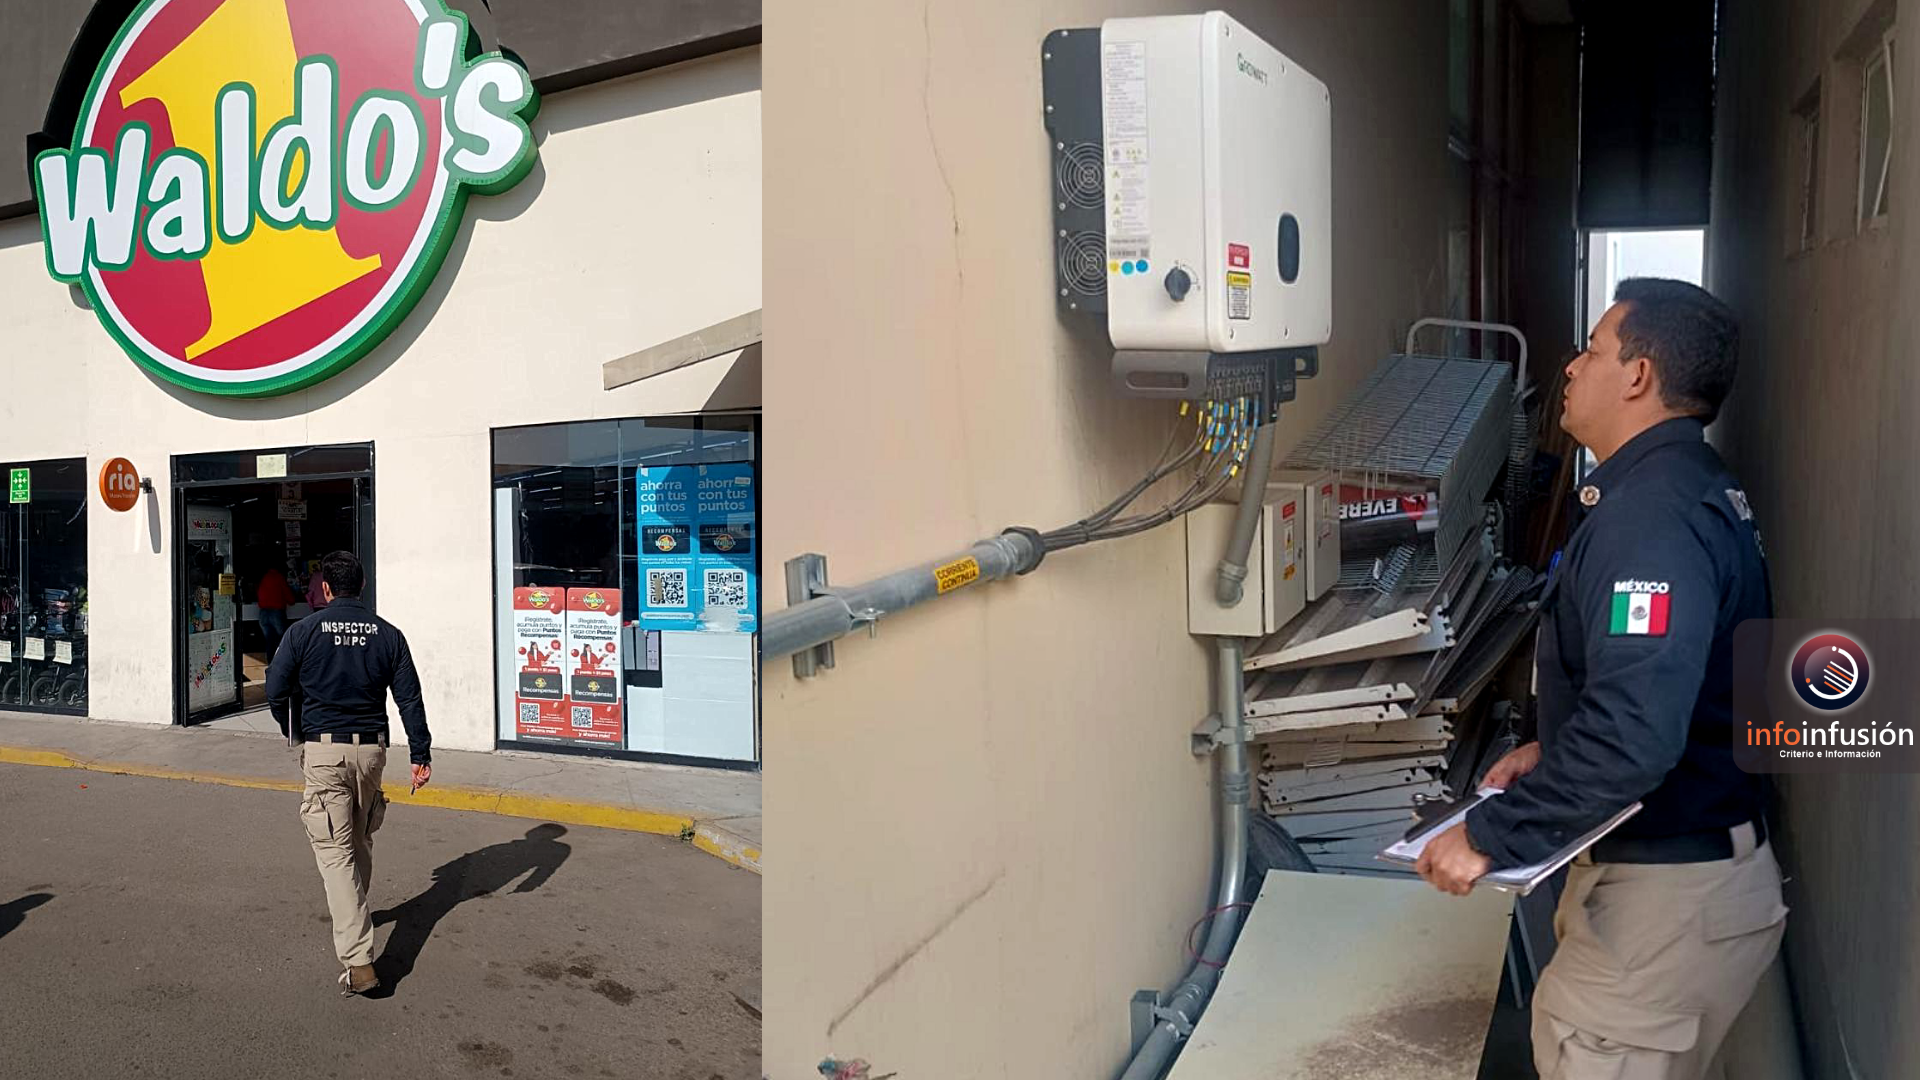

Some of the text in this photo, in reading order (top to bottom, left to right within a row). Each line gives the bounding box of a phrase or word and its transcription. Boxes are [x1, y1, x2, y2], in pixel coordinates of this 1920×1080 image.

[38, 20, 525, 276] Waldo's
[109, 464, 136, 491] ria
[640, 480, 682, 491] ahorra
[698, 478, 736, 489] ahorr
[640, 491, 688, 502] con tus
[698, 489, 748, 500] con tus
[640, 503, 686, 515] puntos
[698, 501, 746, 513] puntos
[1613, 578, 1670, 594] MÉXICO
[321, 621, 379, 635] INSPECTOR
[522, 686, 559, 694] Recompensas
[574, 689, 614, 698] Recompensas
